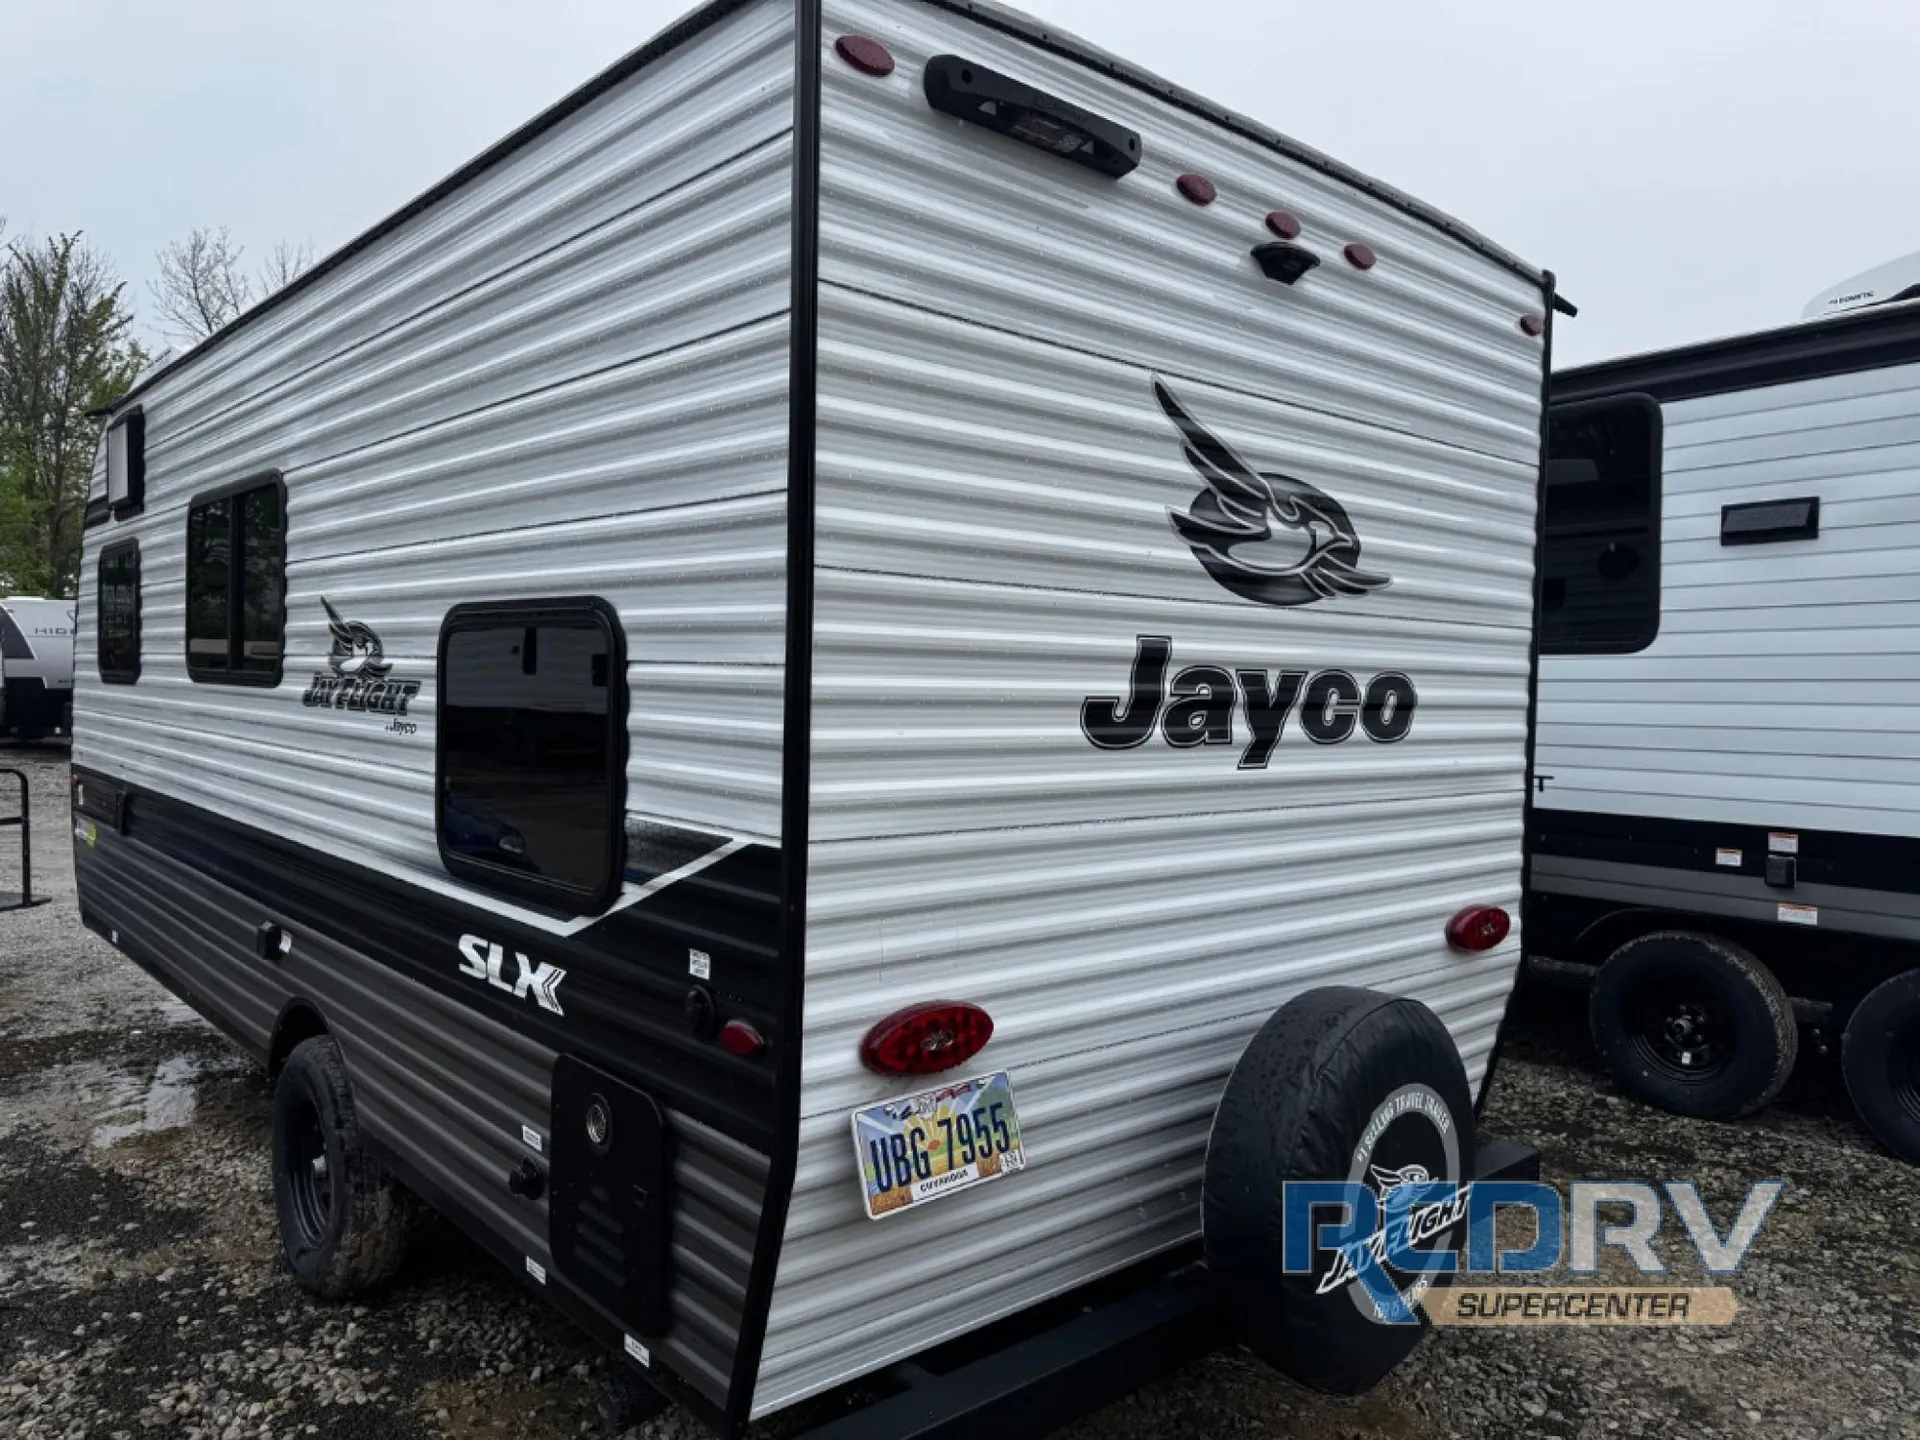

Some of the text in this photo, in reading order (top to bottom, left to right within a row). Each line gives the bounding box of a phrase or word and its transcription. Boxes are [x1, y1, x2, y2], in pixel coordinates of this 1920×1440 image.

[1080, 634, 1418, 770] Jayco
[458, 933, 567, 1017] SLX
[869, 1101, 1011, 1193] UBG 7955
